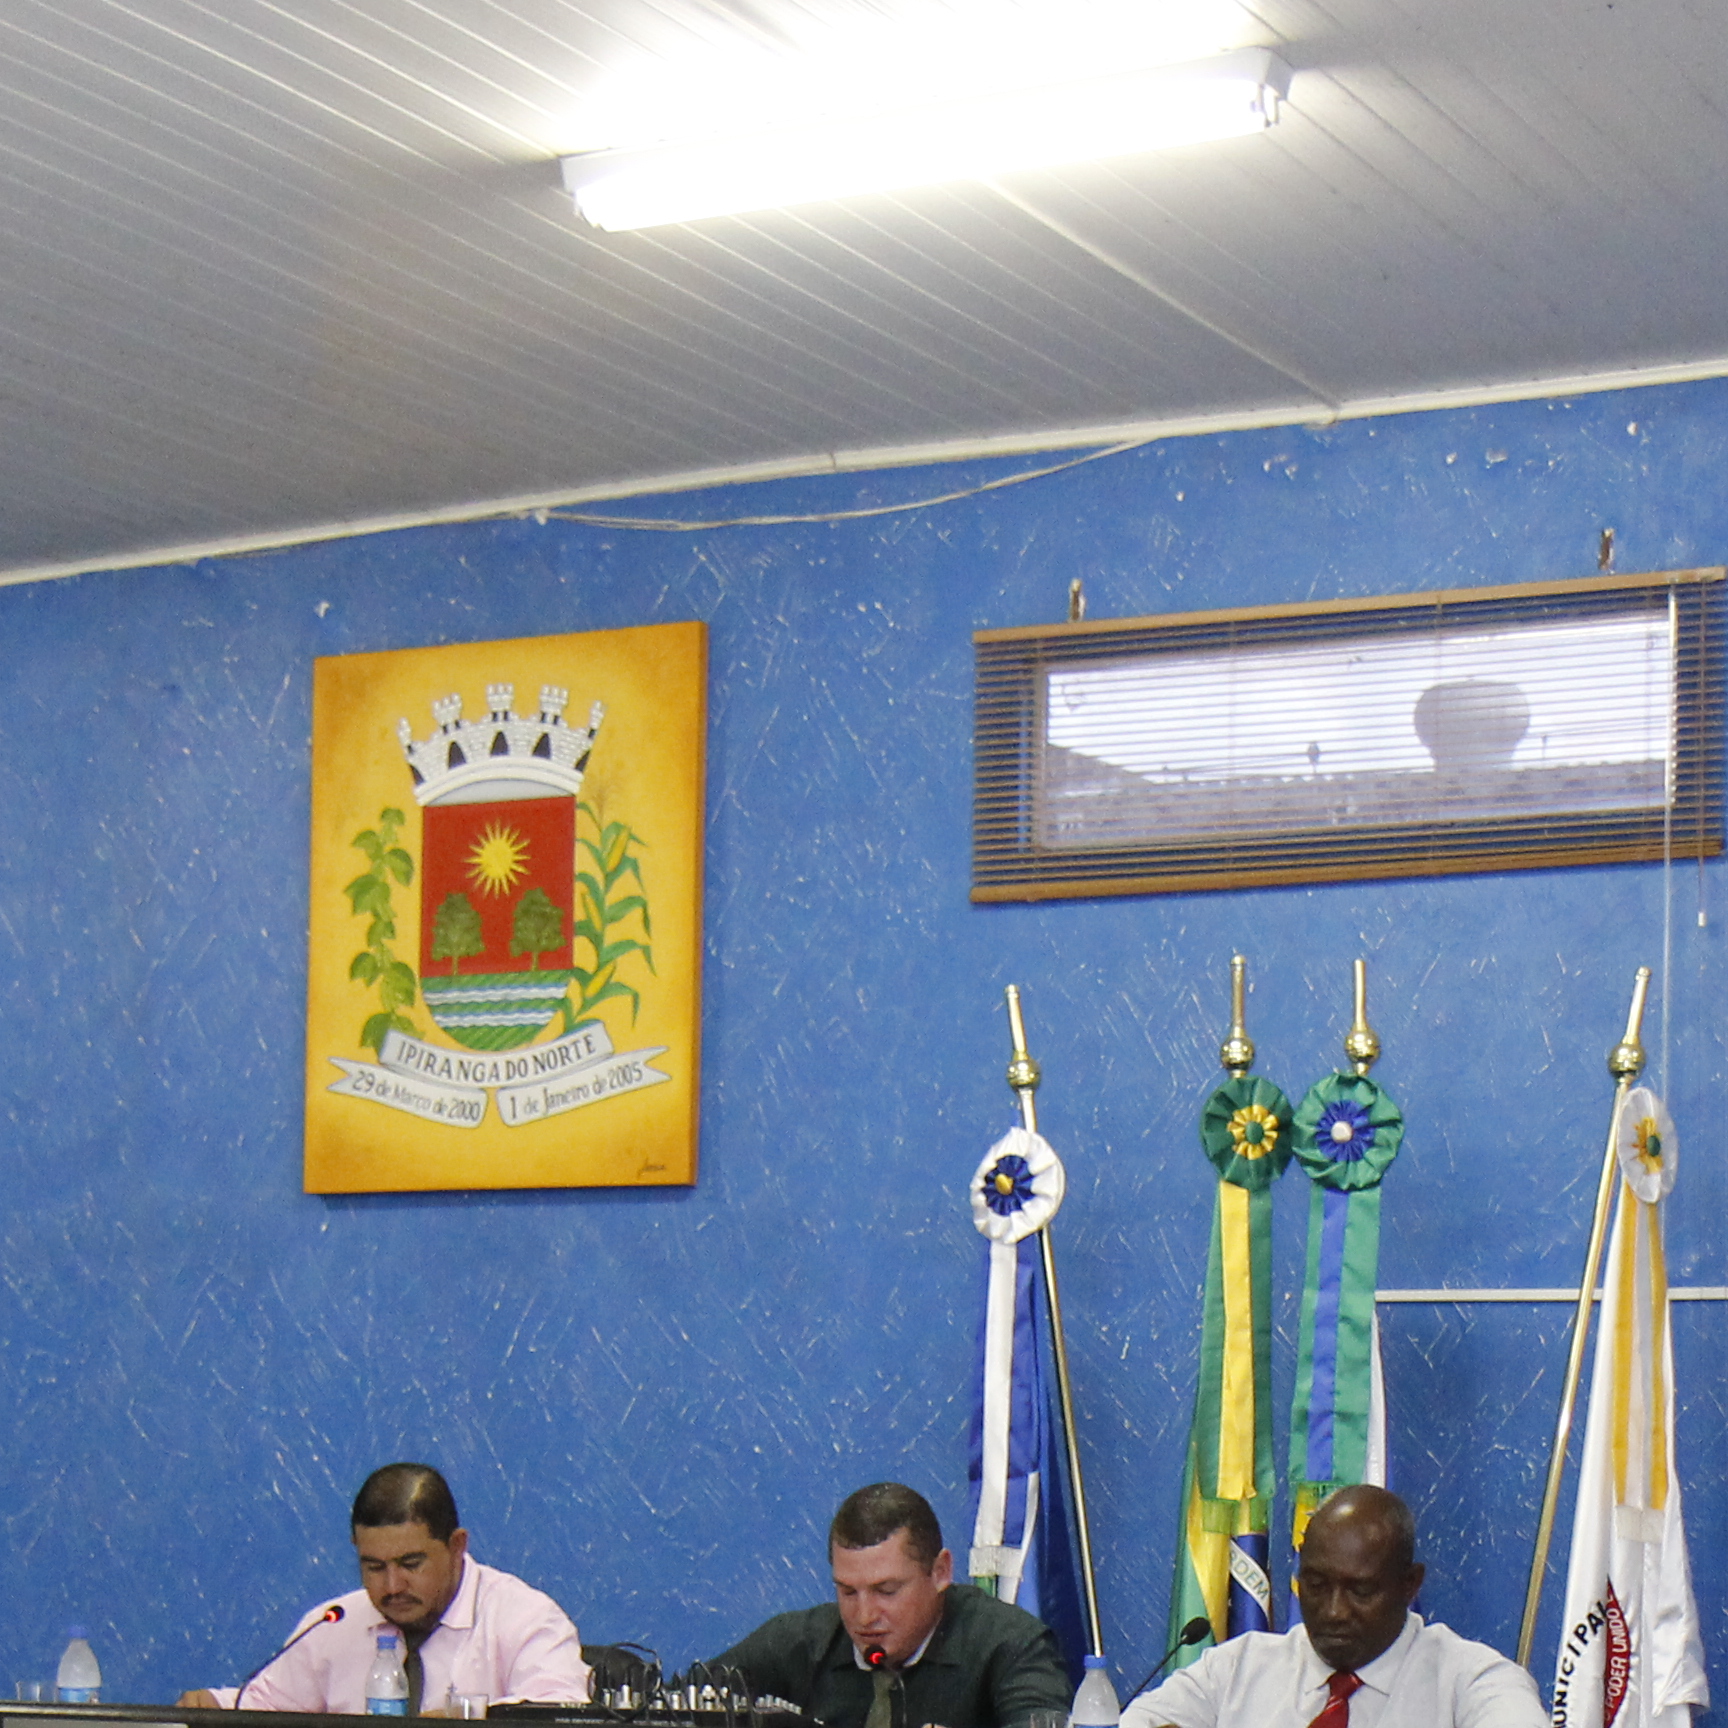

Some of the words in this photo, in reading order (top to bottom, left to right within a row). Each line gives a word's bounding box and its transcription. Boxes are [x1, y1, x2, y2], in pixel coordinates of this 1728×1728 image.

[397, 1041, 501, 1083] IPIRANGA
[505, 1058, 528, 1081] DO
[531, 1033, 597, 1075] NORTE
[352, 1069, 376, 1093] 29
[376, 1080, 391, 1097] de
[433, 1097, 449, 1116] de
[449, 1097, 481, 1122] 2000
[510, 1095, 517, 1120] 1
[542, 1086, 591, 1116] Janeiro
[607, 1060, 644, 1091] 2005
[1606, 1607, 1628, 1653] UNIDO
[1606, 1656, 1628, 1709] PODER
